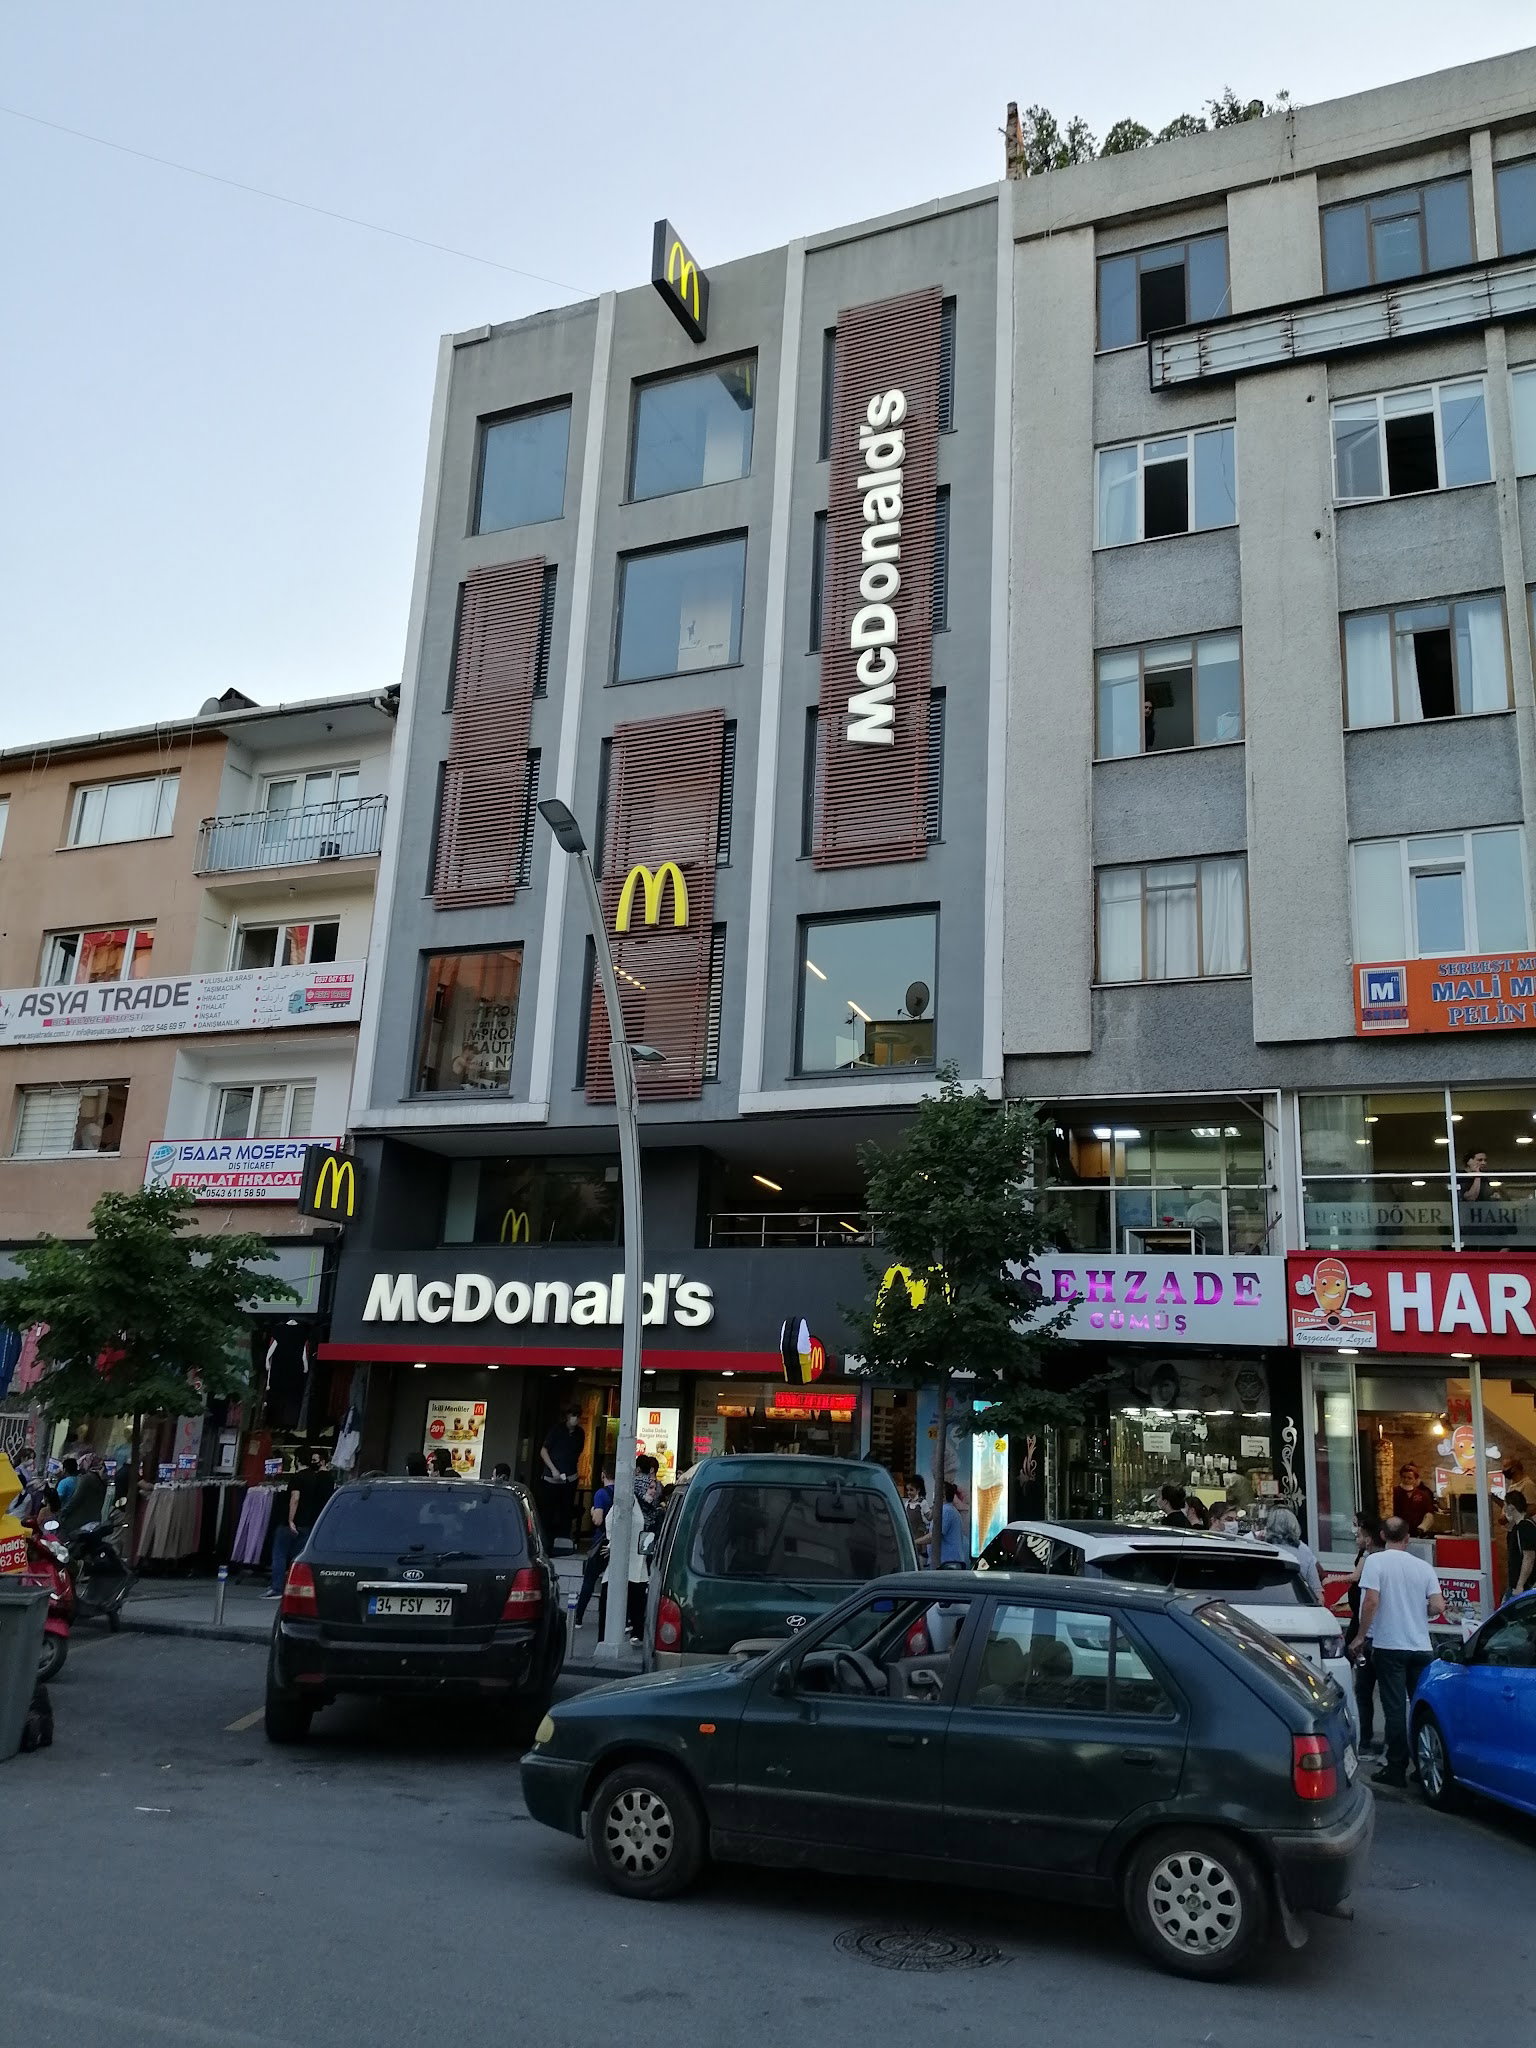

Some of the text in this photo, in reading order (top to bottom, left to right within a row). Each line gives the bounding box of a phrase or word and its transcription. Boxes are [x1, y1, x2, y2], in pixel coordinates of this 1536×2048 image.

[847, 388, 907, 746] McDonald's
[1438, 959, 1513, 976] SERBEST
[1432, 973, 1502, 1002] MALİ
[18, 981, 192, 1017] ASYA TRADE
[1447, 999, 1526, 1026] PELİN
[178, 1145, 232, 1161] ISAAR
[243, 1160, 275, 1170] TİCARET
[206, 1188, 266, 1198] 0543 611 58 50
[1377, 1204, 1443, 1224] DÖNER
[362, 1273, 715, 1327] McDonald's
[1089, 1310, 1187, 1335] GÜMÜŞ
[1346, 1333, 1373, 1345] Lezzet
[14, 1551, 27, 1564] 62
[319, 1569, 356, 1577] SORENTO
[1442, 1587, 1468, 1599] ÜSTÜ
[377, 1598, 391, 1613] 34
[400, 1598, 423, 1613] FSV
[435, 1598, 450, 1614] 37
